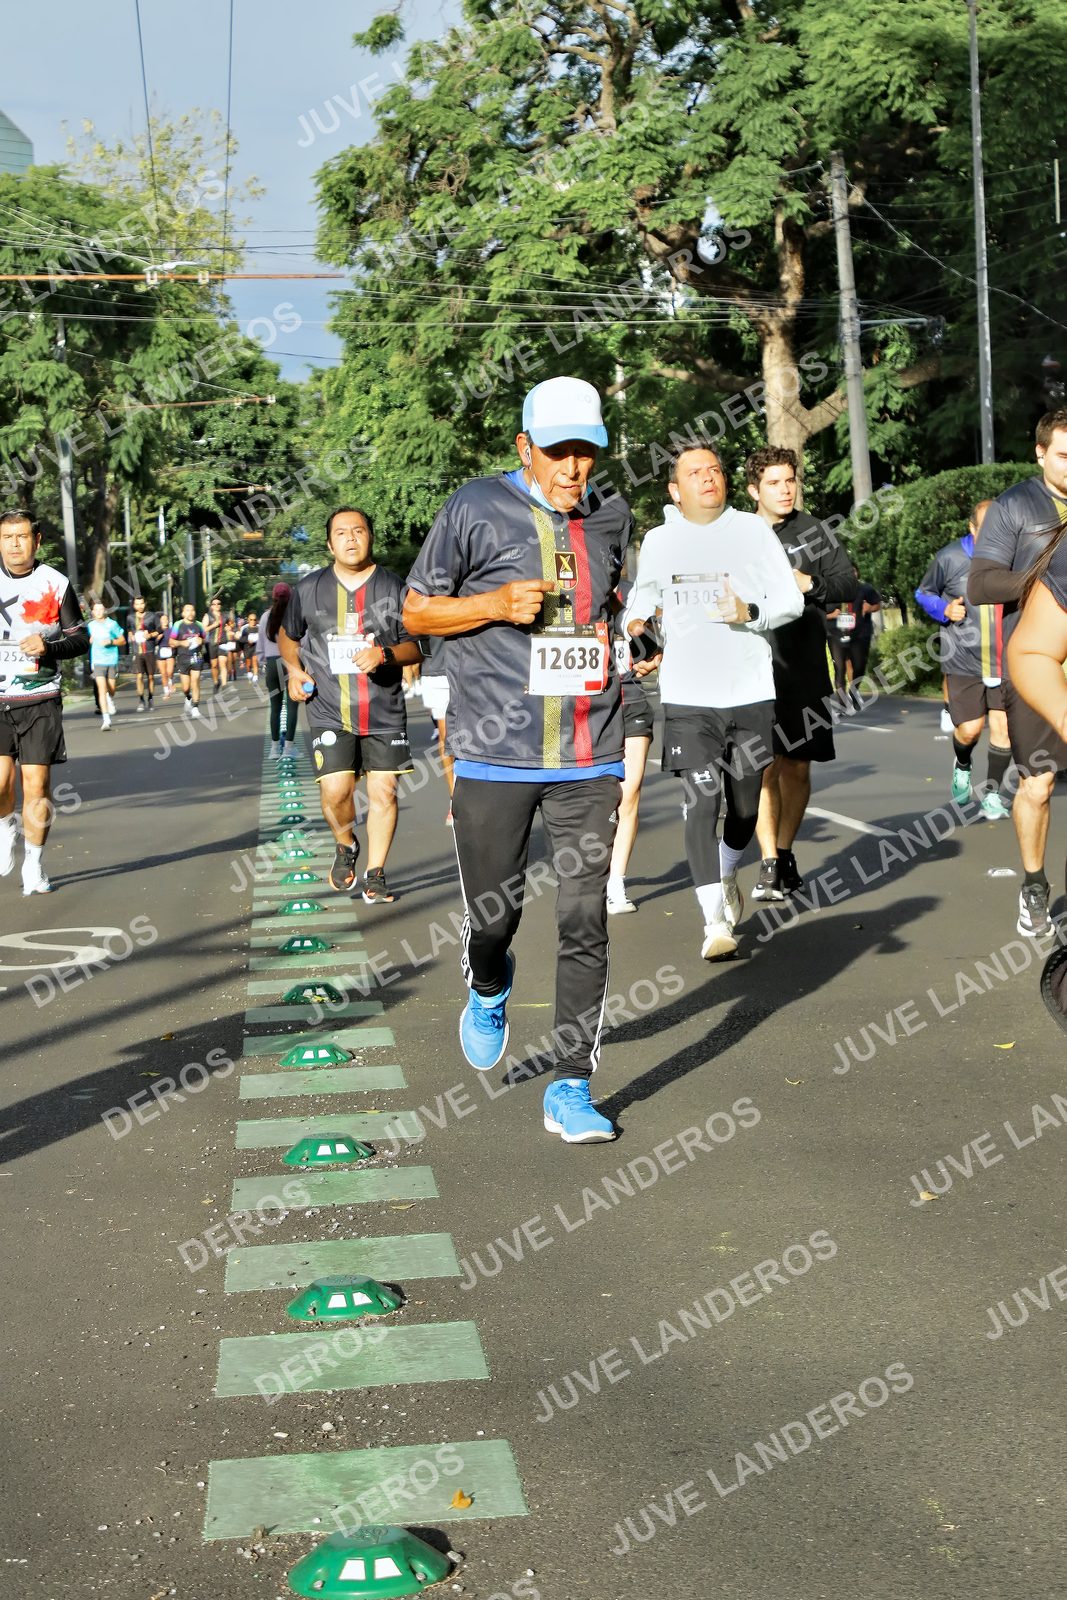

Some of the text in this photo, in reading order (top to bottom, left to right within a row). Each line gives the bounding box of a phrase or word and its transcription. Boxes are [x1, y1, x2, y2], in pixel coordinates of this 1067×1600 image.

[674, 589, 719, 605] 11305
[330, 647, 362, 660] 1308
[537, 647, 600, 670] 12638
